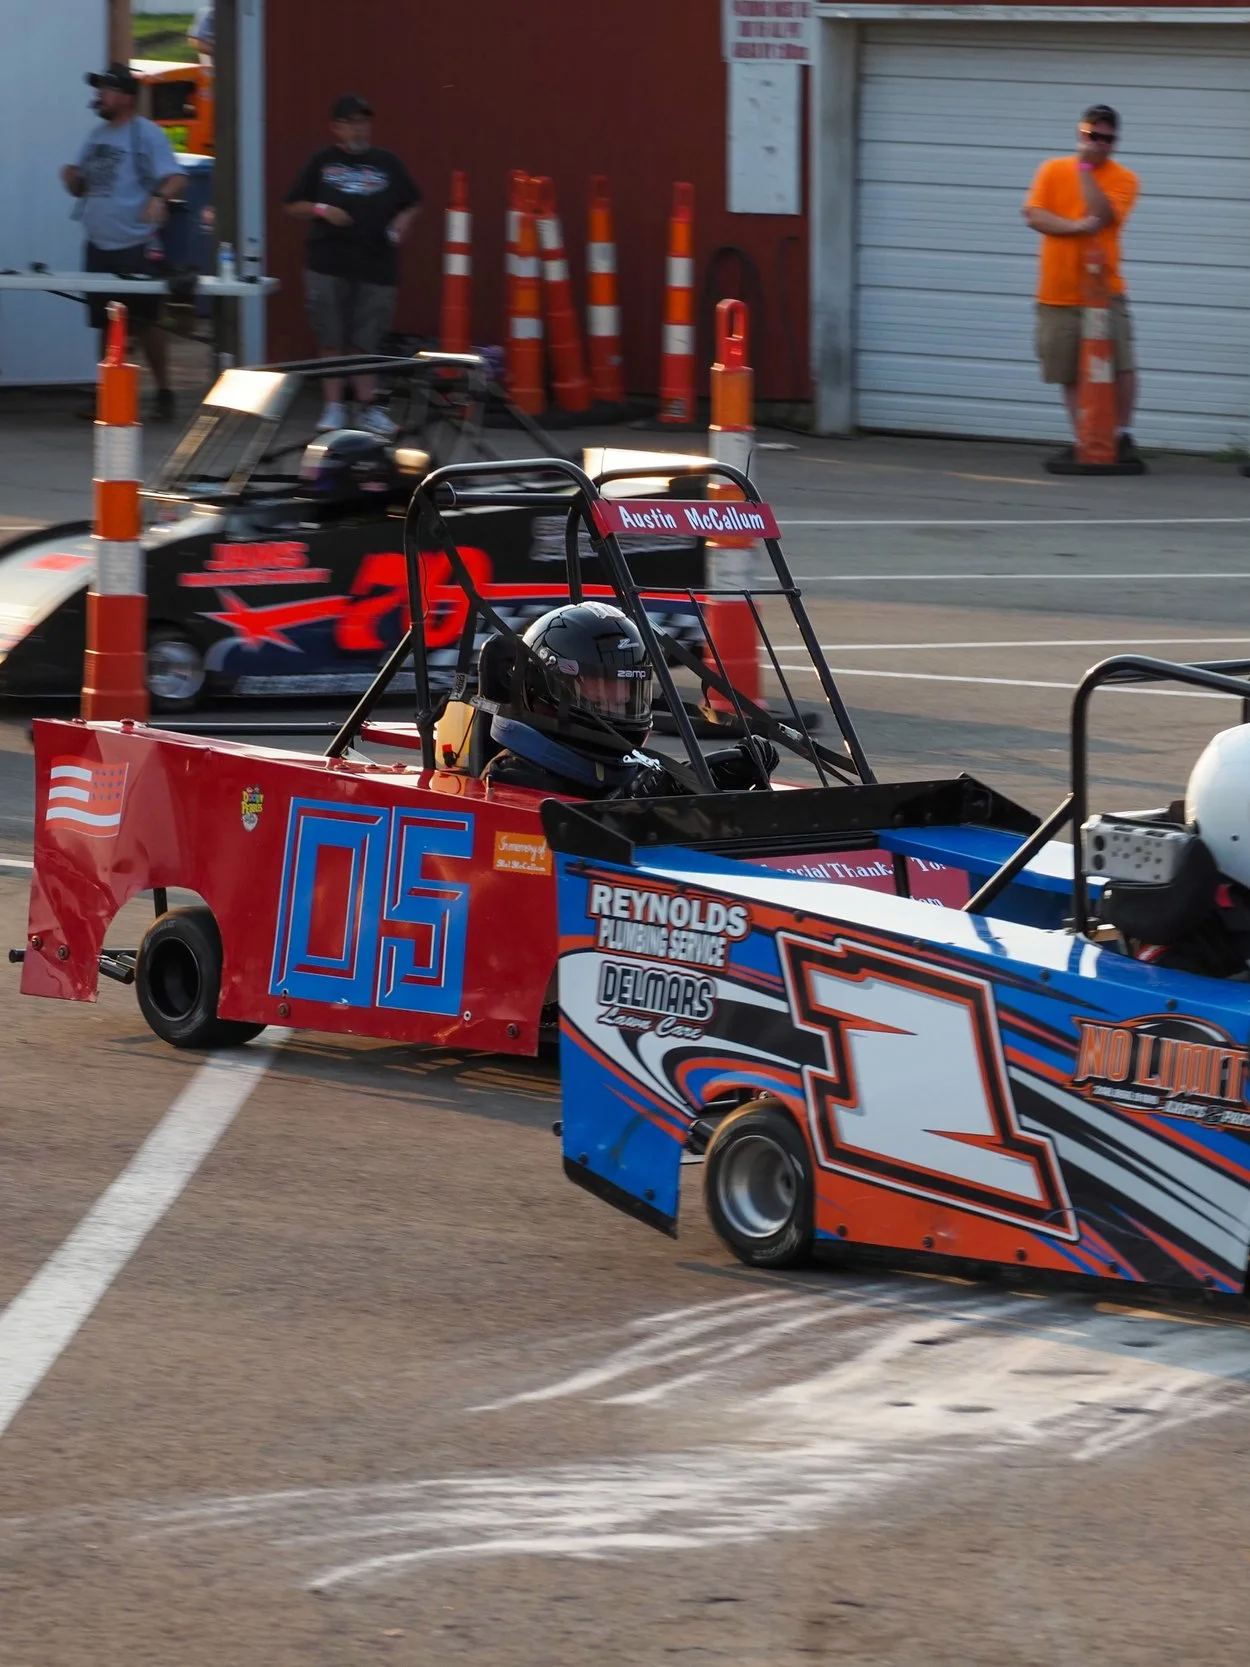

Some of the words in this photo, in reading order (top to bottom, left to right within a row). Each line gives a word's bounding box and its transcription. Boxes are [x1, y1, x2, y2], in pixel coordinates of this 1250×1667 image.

[618, 505, 677, 529] Austin
[684, 506, 765, 531] McCallum
[617, 669, 646, 680] zamp
[826, 861, 895, 878] Thank
[268, 796, 474, 1018] 05
[590, 884, 748, 938] REYNOLDS
[598, 918, 669, 957] PLUMBING
[669, 930, 728, 967] SERVICE
[600, 962, 715, 1021] DELMARS
[597, 1007, 652, 1030] Lawn
[655, 1016, 703, 1040] Care
[780, 935, 1075, 1236] 1
[1074, 1024, 1133, 1082] NO
[1131, 1033, 1250, 1103] LIMIT
